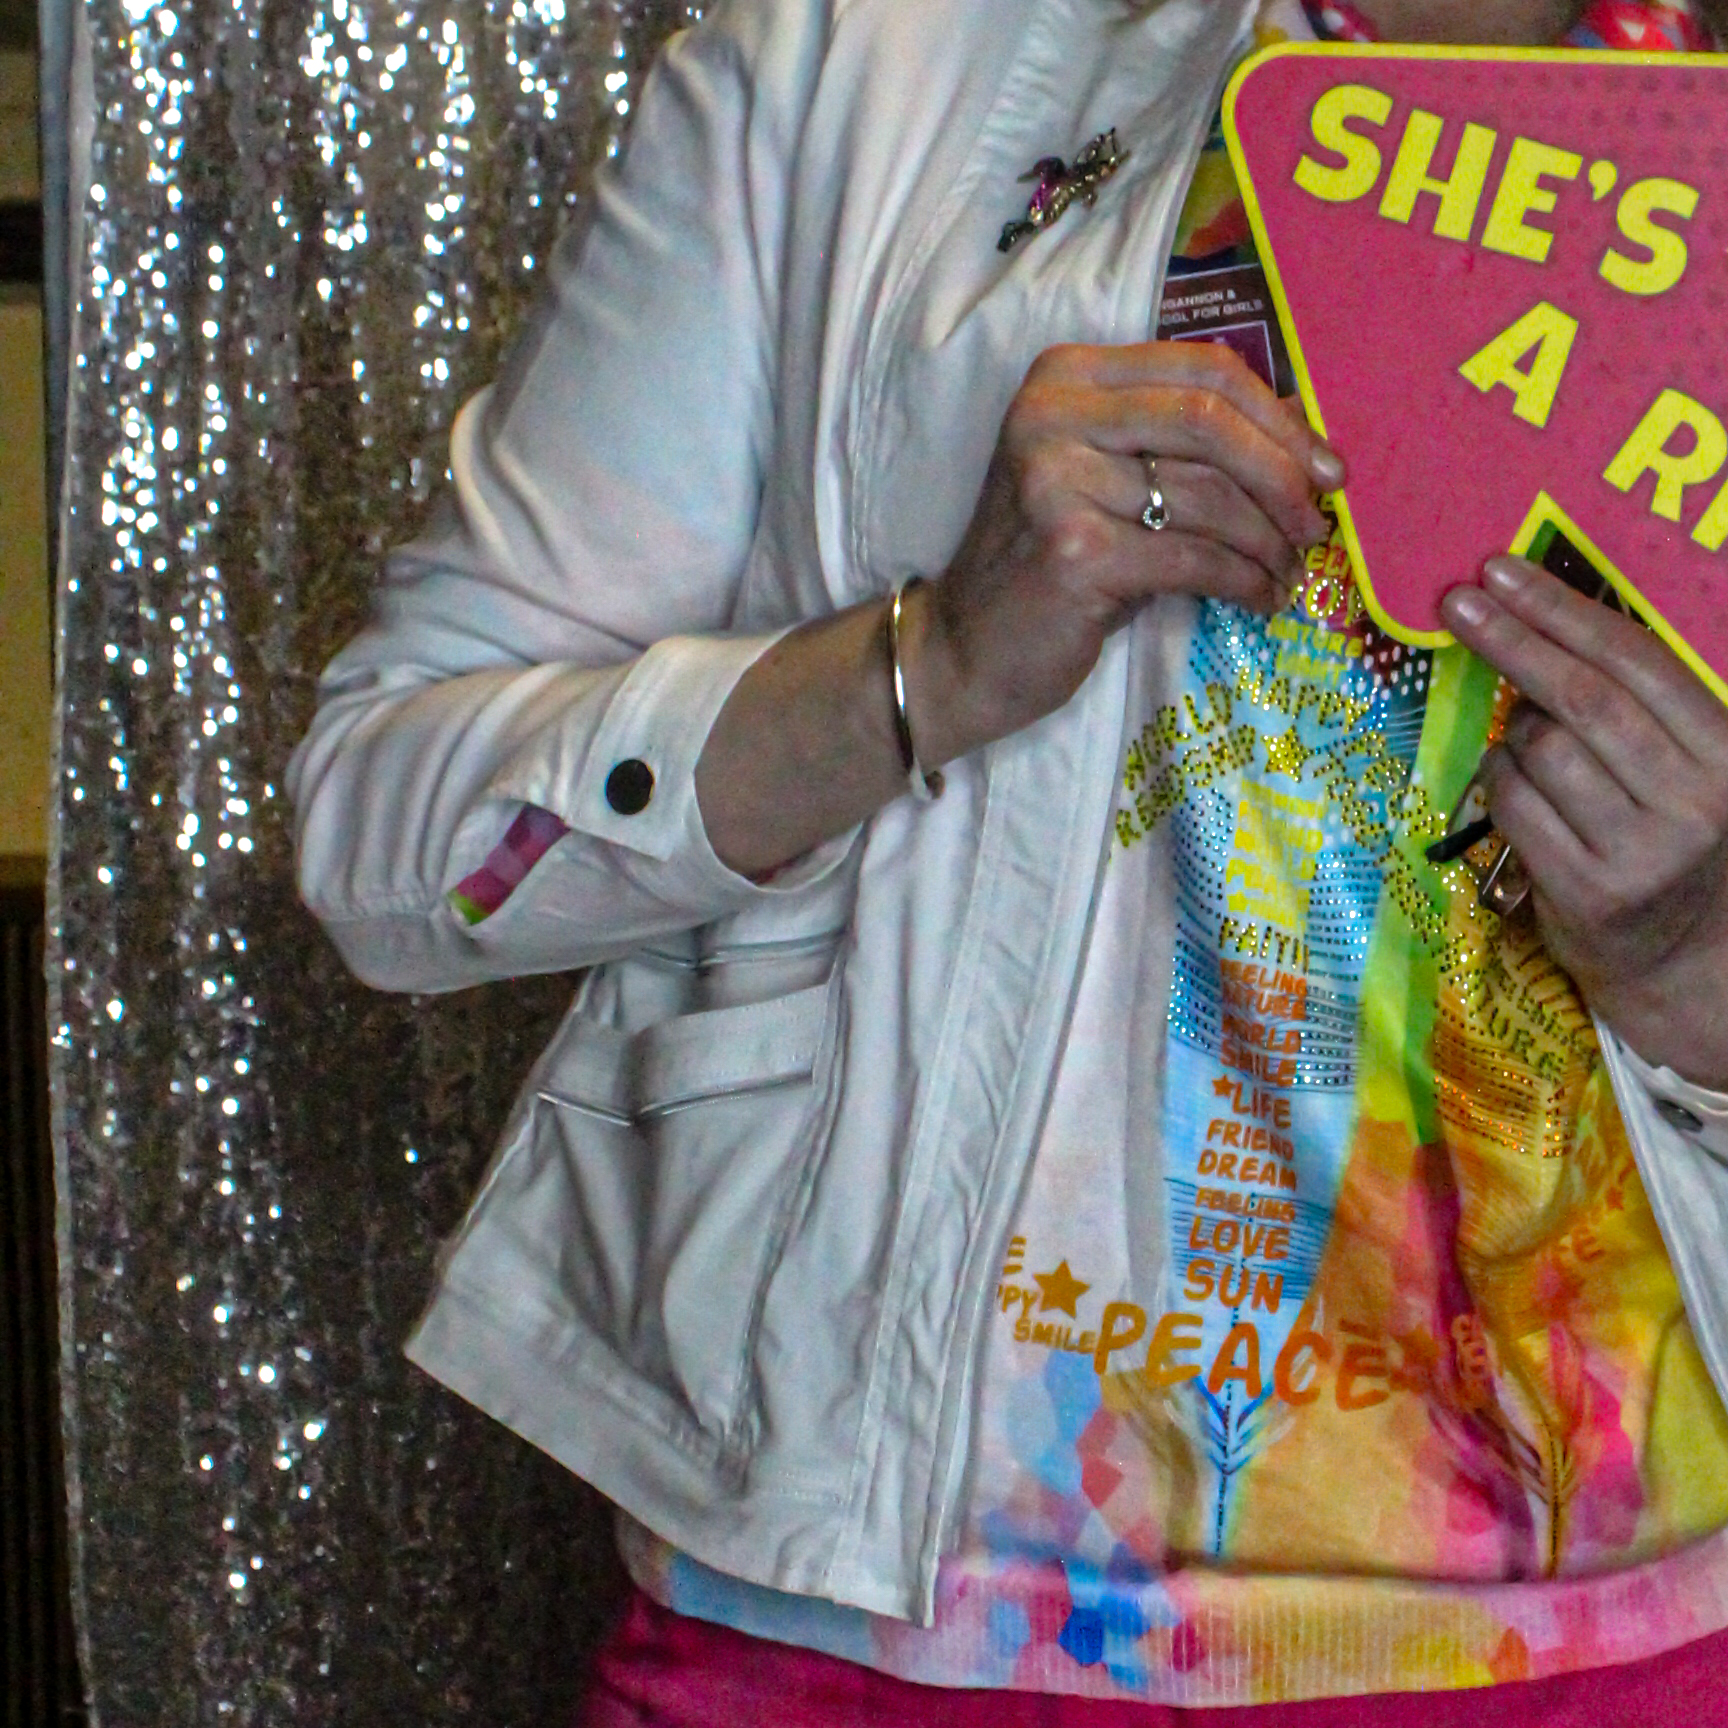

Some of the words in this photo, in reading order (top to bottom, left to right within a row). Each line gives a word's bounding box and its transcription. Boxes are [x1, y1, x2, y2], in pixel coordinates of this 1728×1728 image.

[1292, 83, 1700, 296] SHE'S
[1193, 305, 1220, 320] FOR
[1223, 299, 1262, 315] GIRLS
[1458, 301, 1579, 428] A
[1232, 1082, 1291, 1129] LIFE
[1207, 1119, 1294, 1161] FRIEND
[1197, 1149, 1297, 1191] DREAM
[1189, 1215, 1290, 1260] LOVE
[1183, 1258, 1284, 1314] SUN
[1014, 1317, 1097, 1355] SMILE
[1094, 1302, 1390, 1411] PEACE
